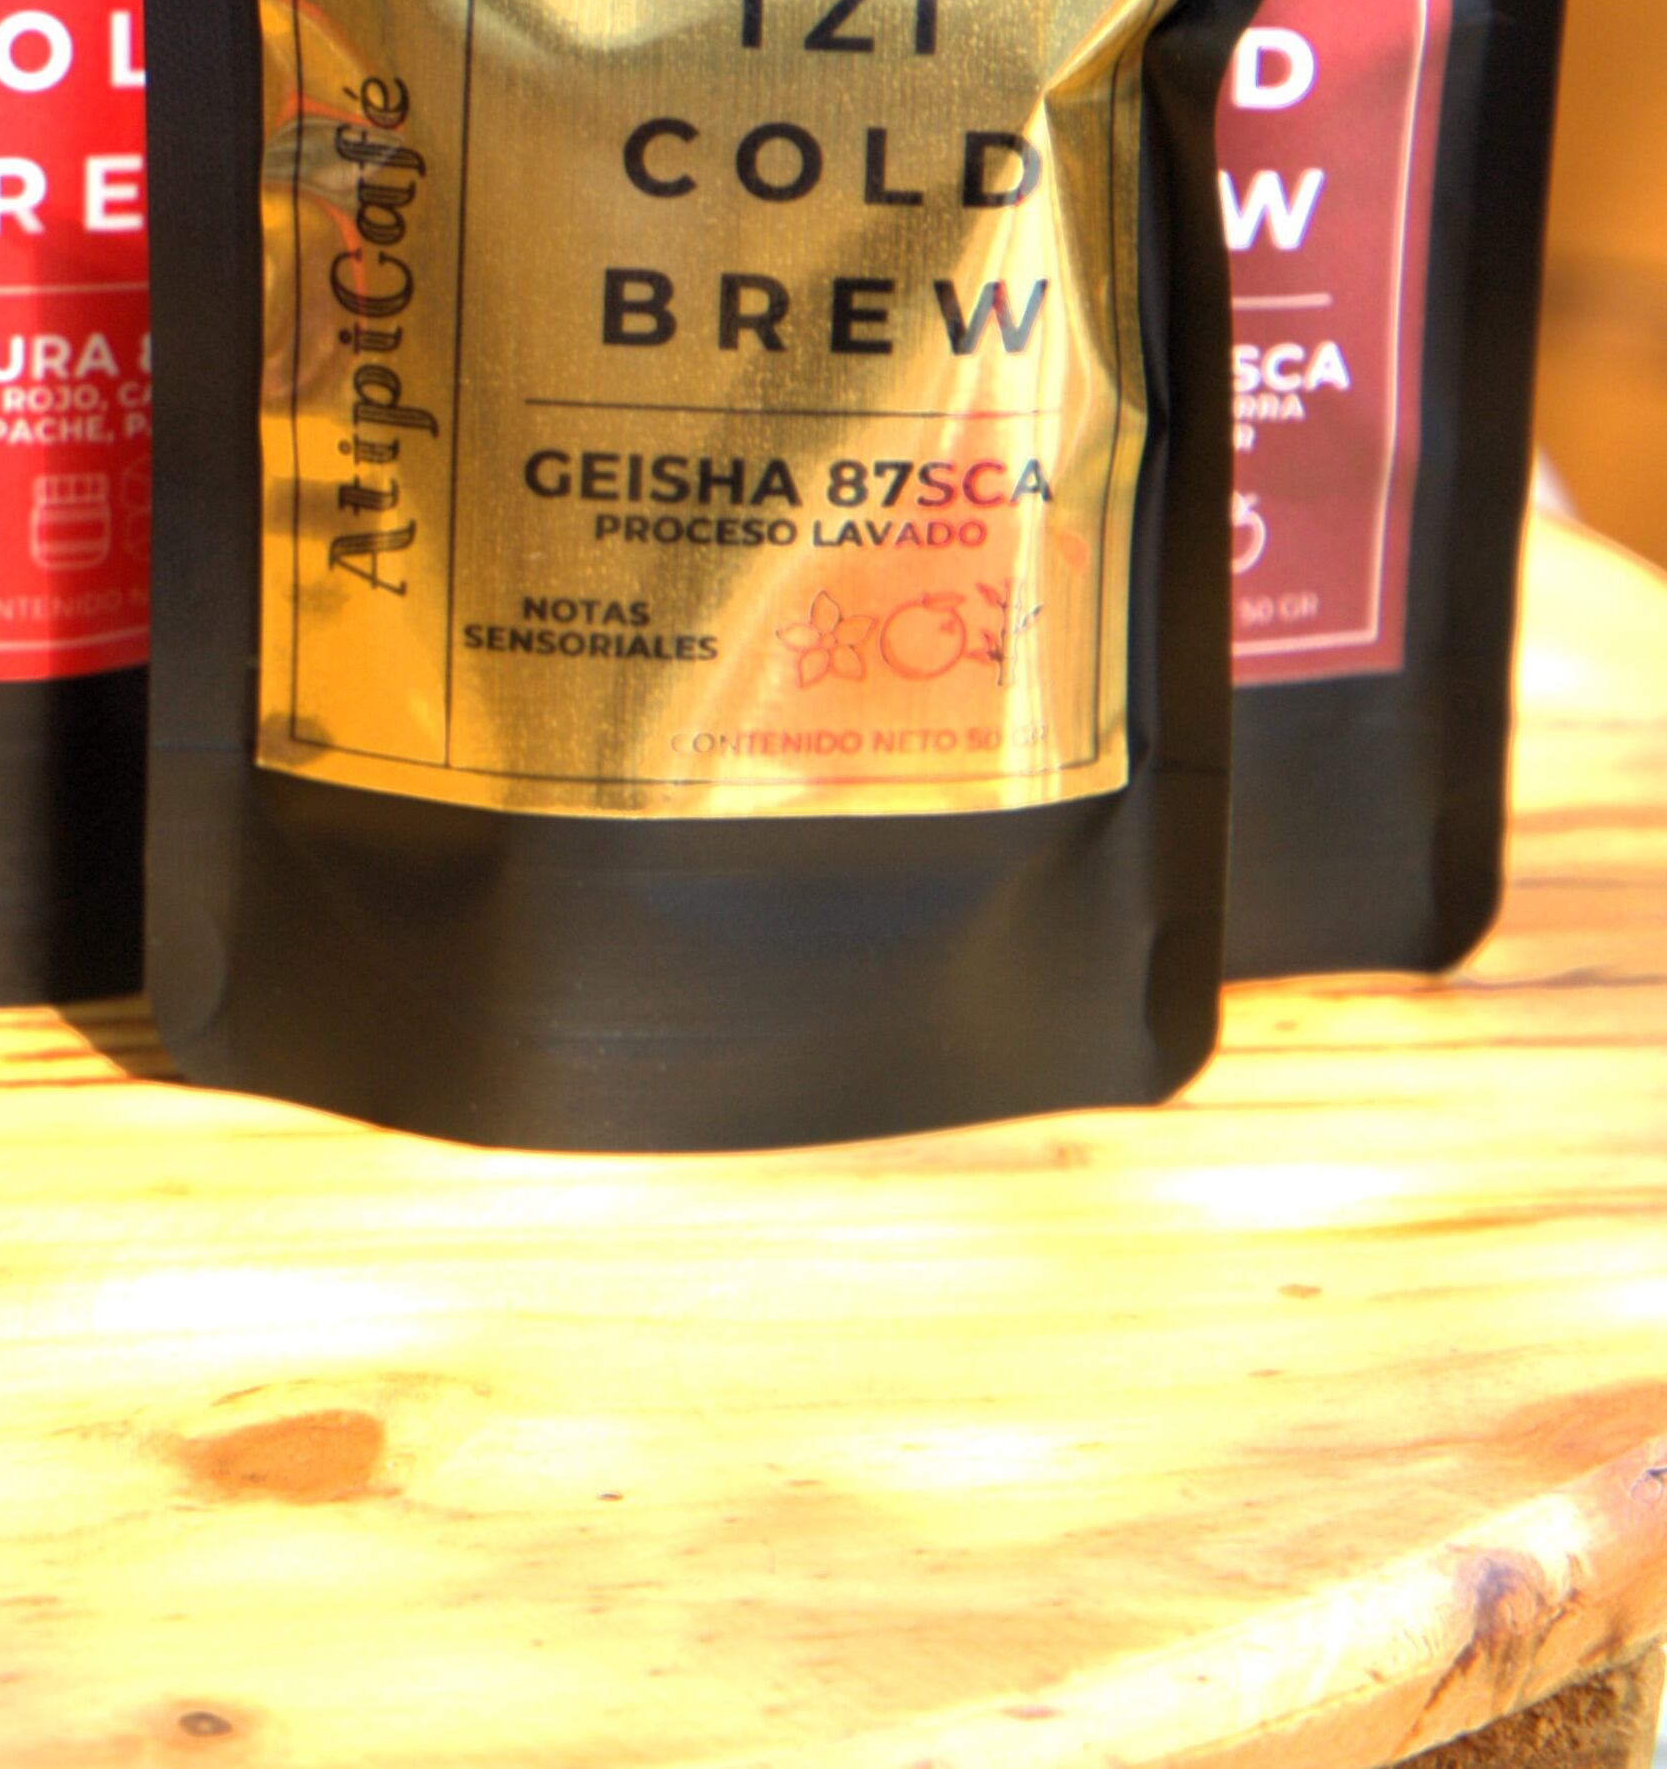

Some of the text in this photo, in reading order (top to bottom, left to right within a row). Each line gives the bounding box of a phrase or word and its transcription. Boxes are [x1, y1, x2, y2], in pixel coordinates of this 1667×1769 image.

[621, 116, 1044, 211] COLD
[600, 266, 1051, 358] BREW
[329, 75, 439, 597] AtipiCafé
[1232, 340, 1351, 394] SCA
[1, 383, 108, 413] ROJO,
[522, 448, 1054, 509] GEISHA 87SCA
[594, 513, 988, 551] PROCESO LAVADO
[522, 597, 651, 627] NOTAS
[463, 624, 719, 663] SENSORIALES
[670, 730, 862, 757] CONTENIDO
[872, 730, 957, 756] NETO
